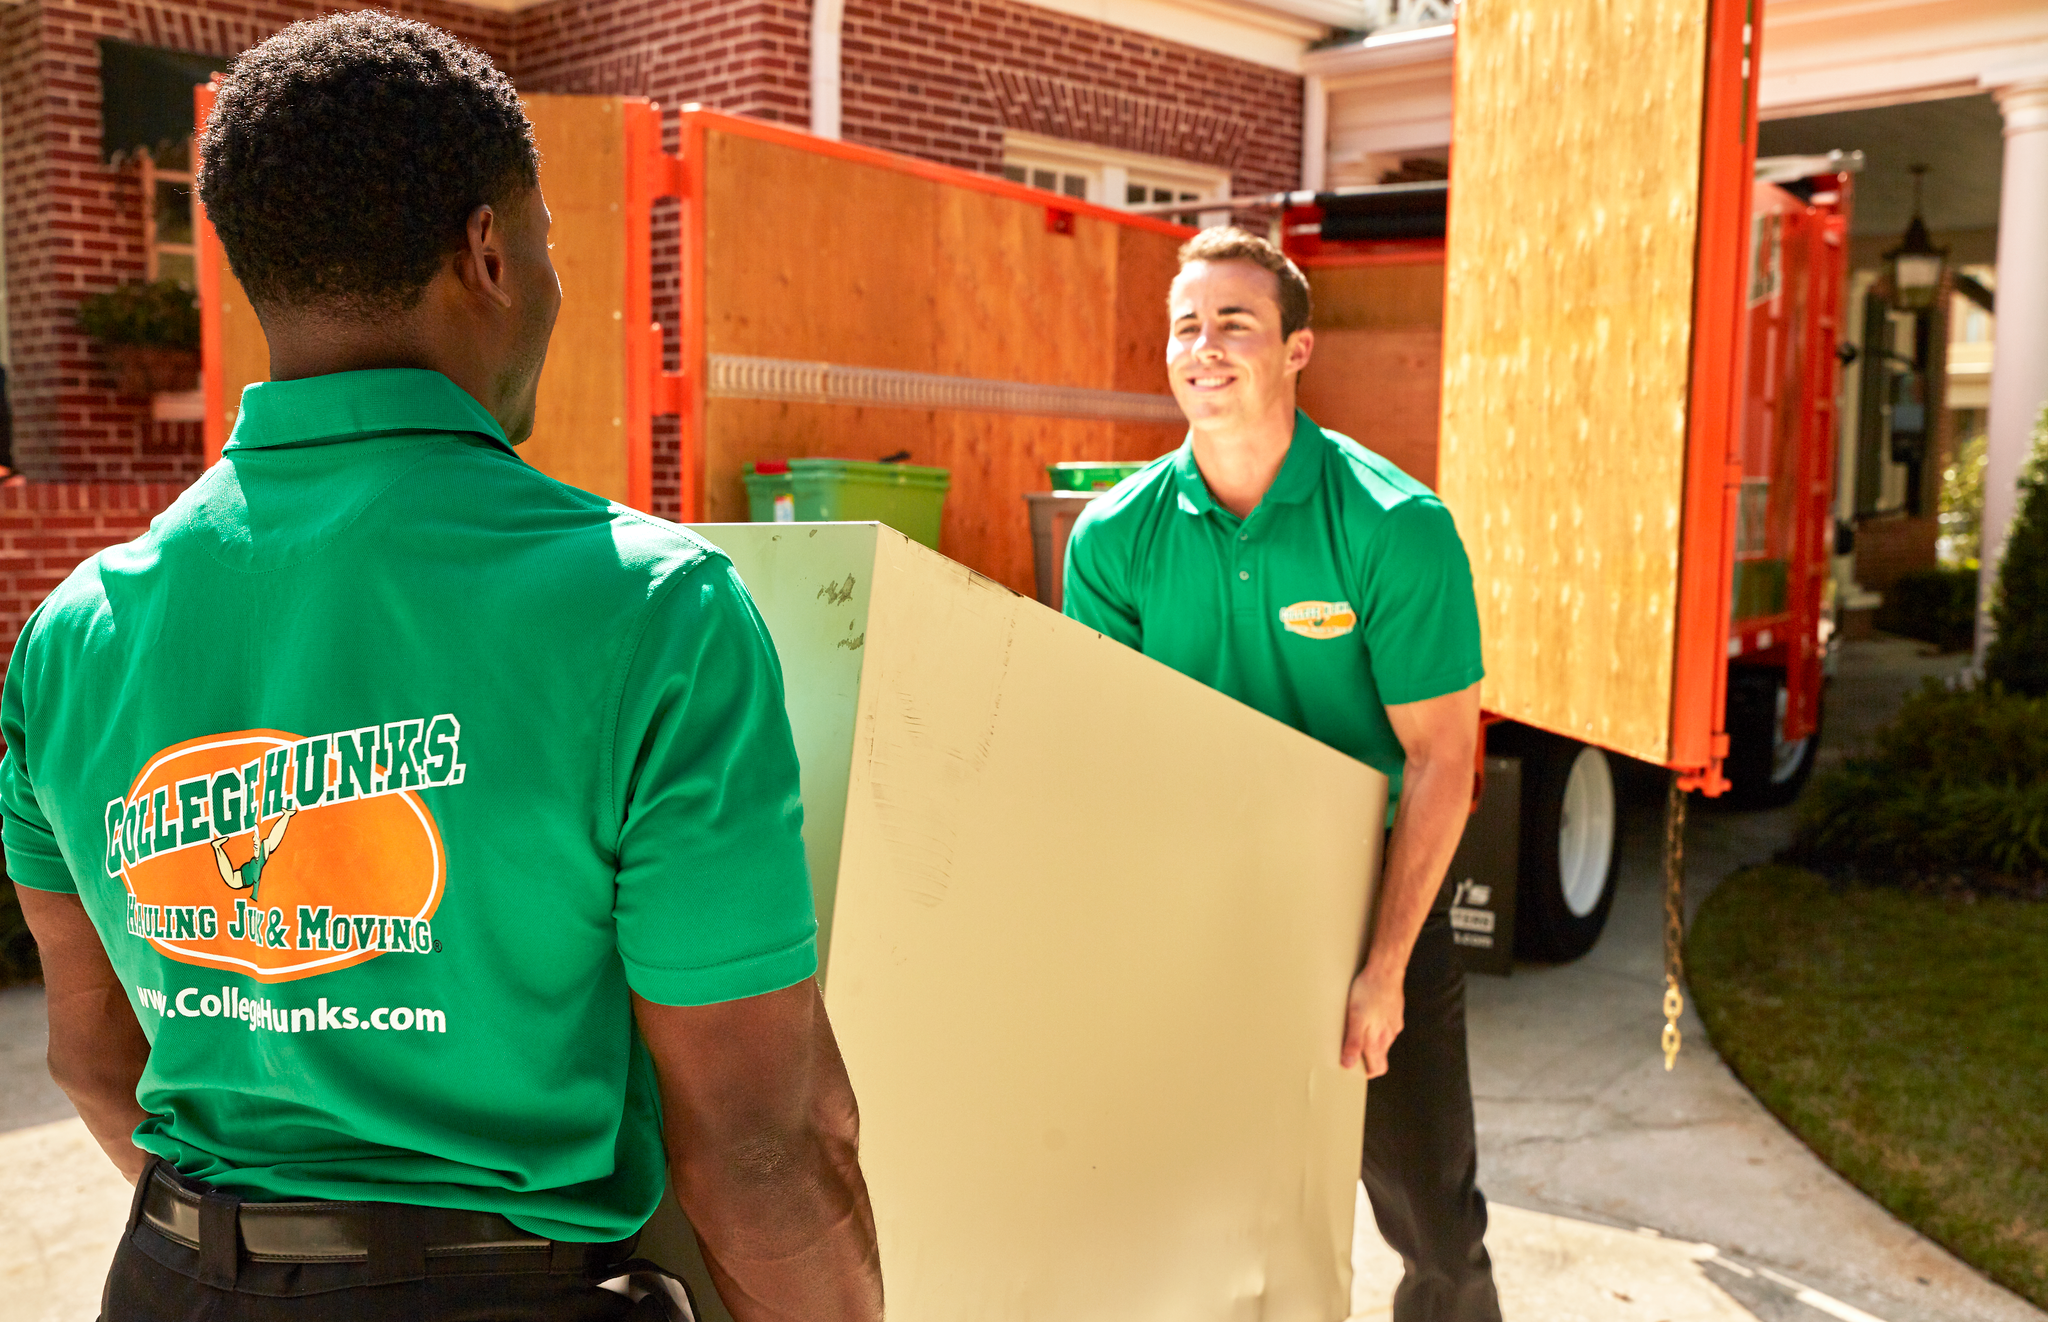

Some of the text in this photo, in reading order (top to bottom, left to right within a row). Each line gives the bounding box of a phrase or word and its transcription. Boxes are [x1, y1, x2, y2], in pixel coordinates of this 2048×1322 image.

[105, 713, 466, 878] COLLEGE H.U.N.K.S.
[127, 893, 218, 940] HAULING
[227, 898, 265, 947] JUK
[265, 906, 292, 950] &
